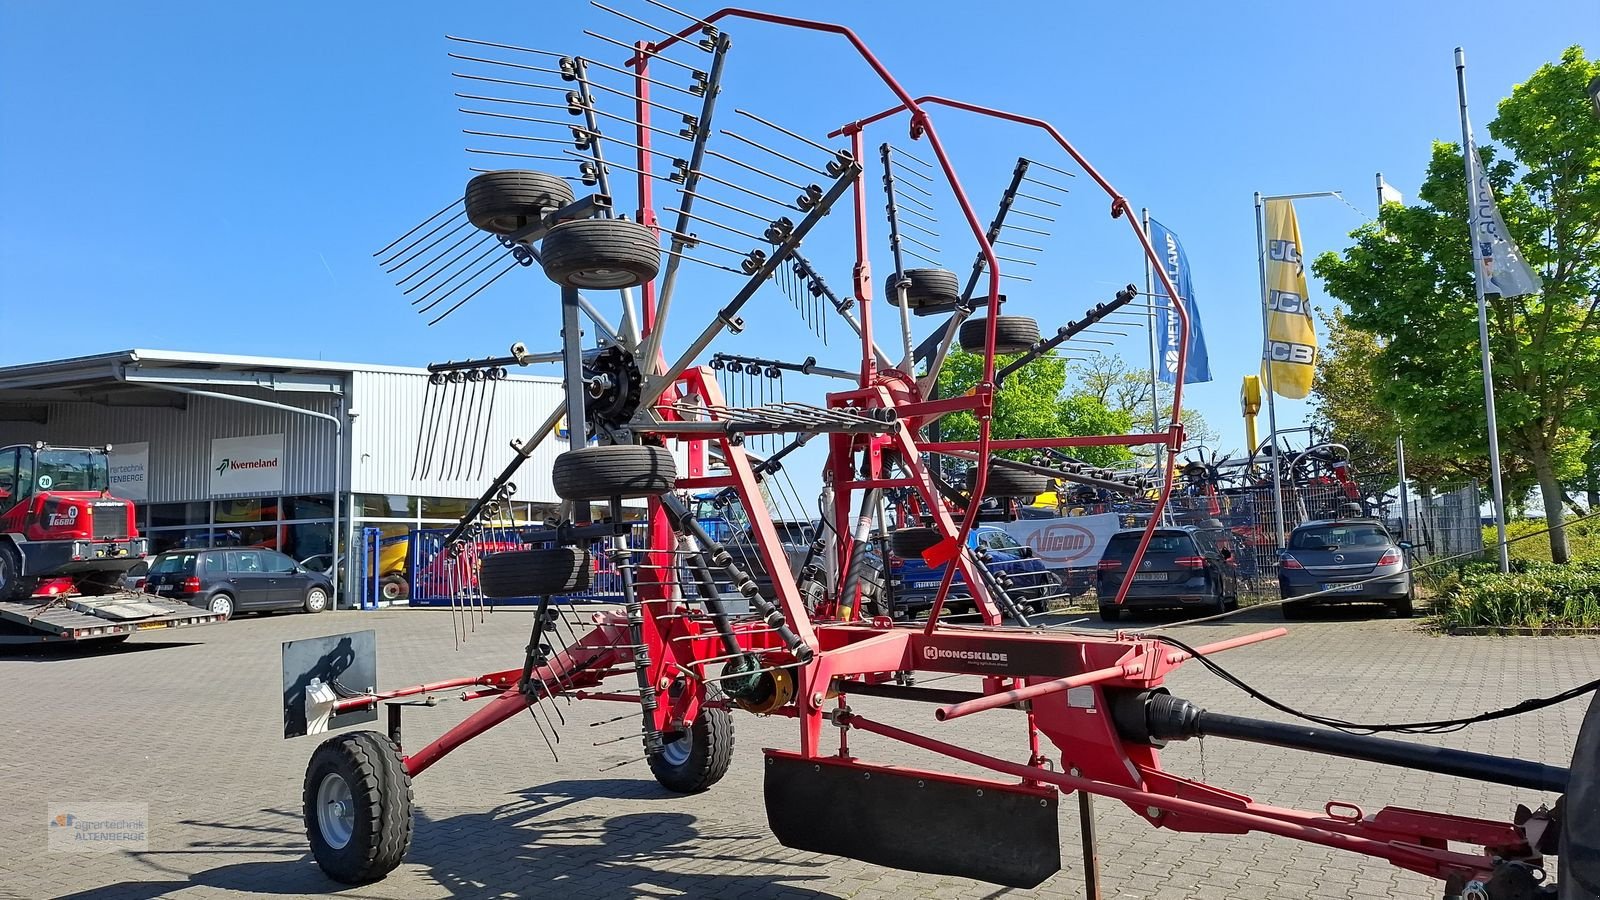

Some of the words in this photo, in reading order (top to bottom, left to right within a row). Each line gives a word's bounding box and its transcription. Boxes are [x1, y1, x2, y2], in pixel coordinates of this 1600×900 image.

[109, 464, 144, 474] rartechnik
[230, 457, 278, 470] Kverneland
[41, 478, 50, 486] 20
[109, 473, 144, 484] TENBERGE
[1035, 529, 1086, 553] Vicon
[938, 649, 1008, 662] KONGSKILDE
